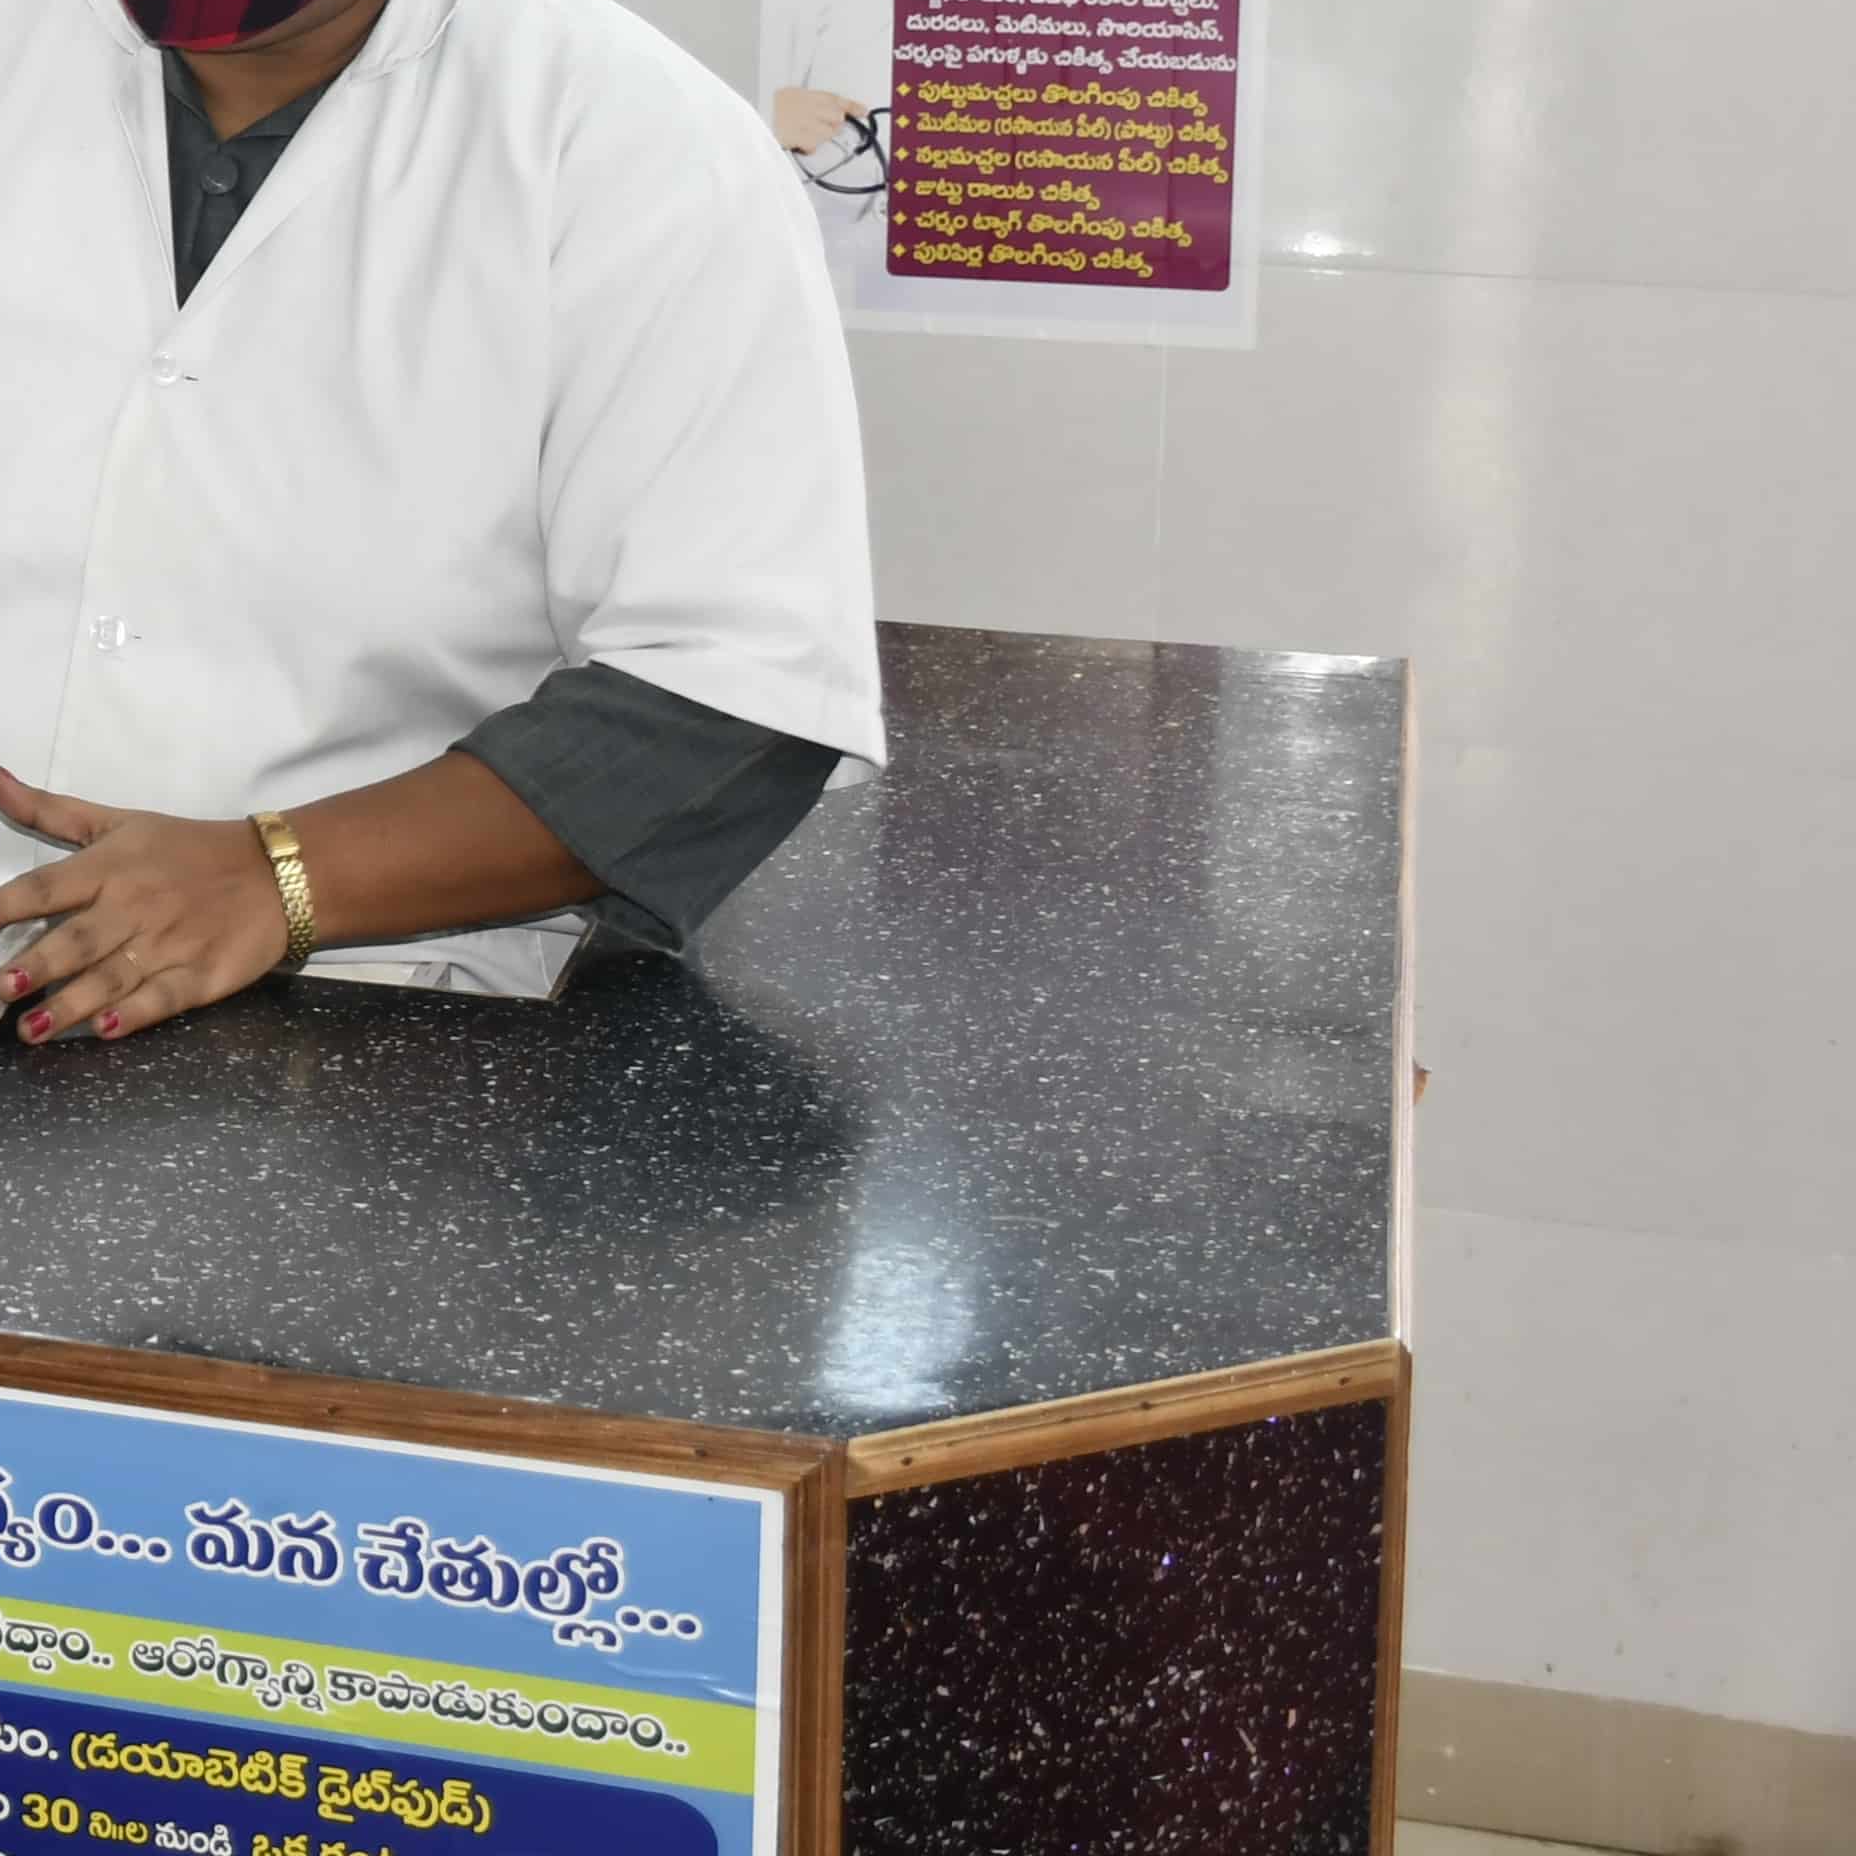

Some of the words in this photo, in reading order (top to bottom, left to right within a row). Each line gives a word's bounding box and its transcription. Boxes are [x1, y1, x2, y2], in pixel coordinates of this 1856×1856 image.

[189, 1500, 341, 1586] మన
[130, 1635, 326, 1712] ఆరోగ్యాన్ని
[21, 1792, 79, 1835] 30
